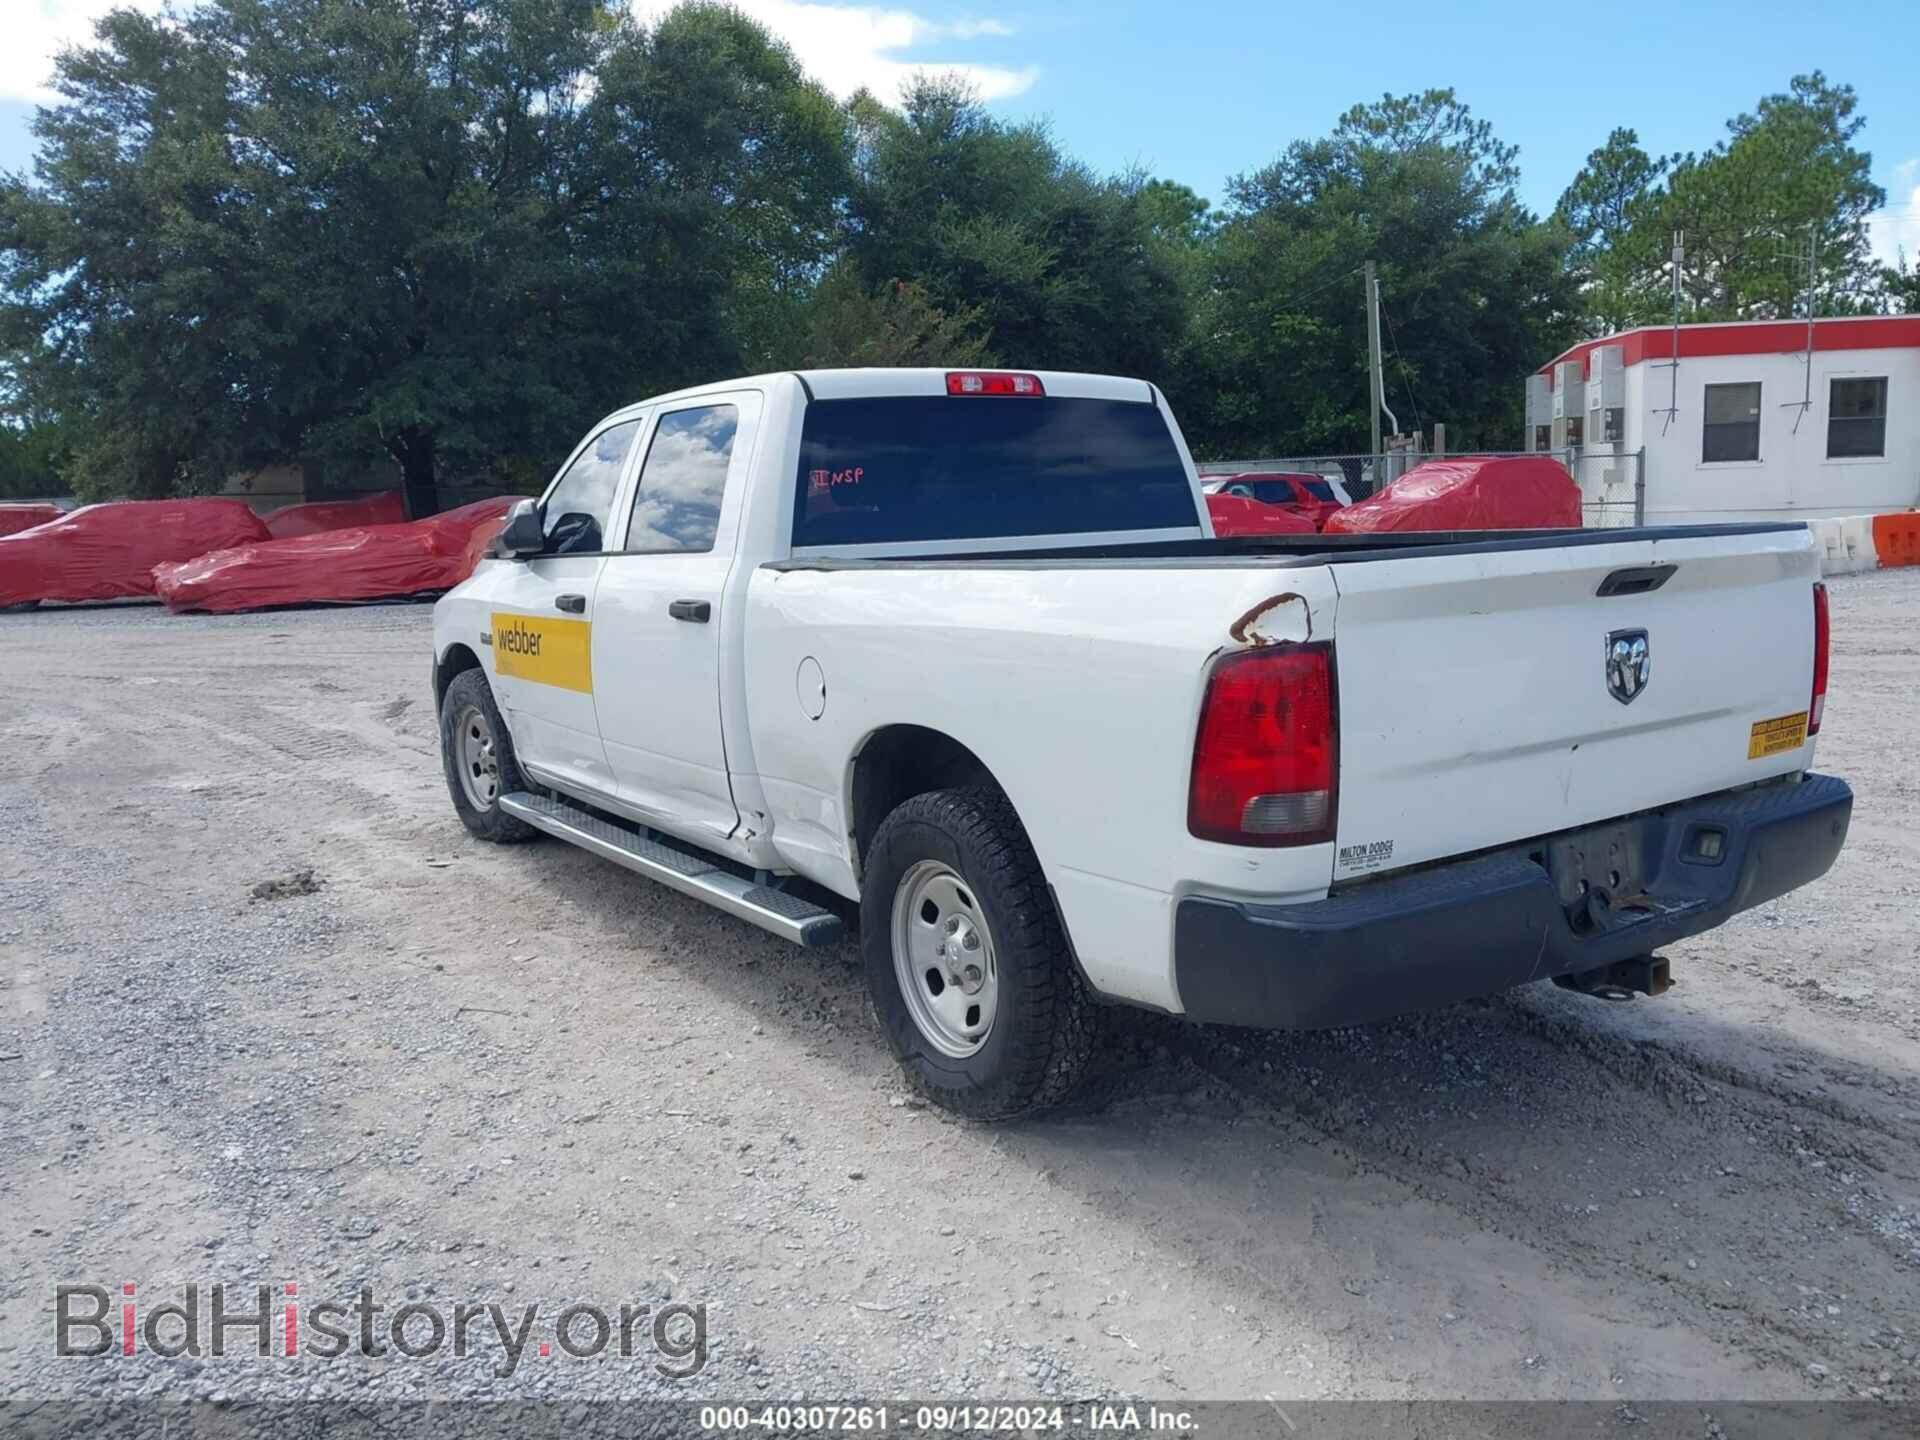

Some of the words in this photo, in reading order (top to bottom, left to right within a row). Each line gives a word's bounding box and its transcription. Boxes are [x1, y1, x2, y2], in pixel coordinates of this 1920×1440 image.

[498, 620, 542, 656] webber
[1340, 844, 1367, 858] MILTON
[1369, 839, 1394, 854] DODGE
